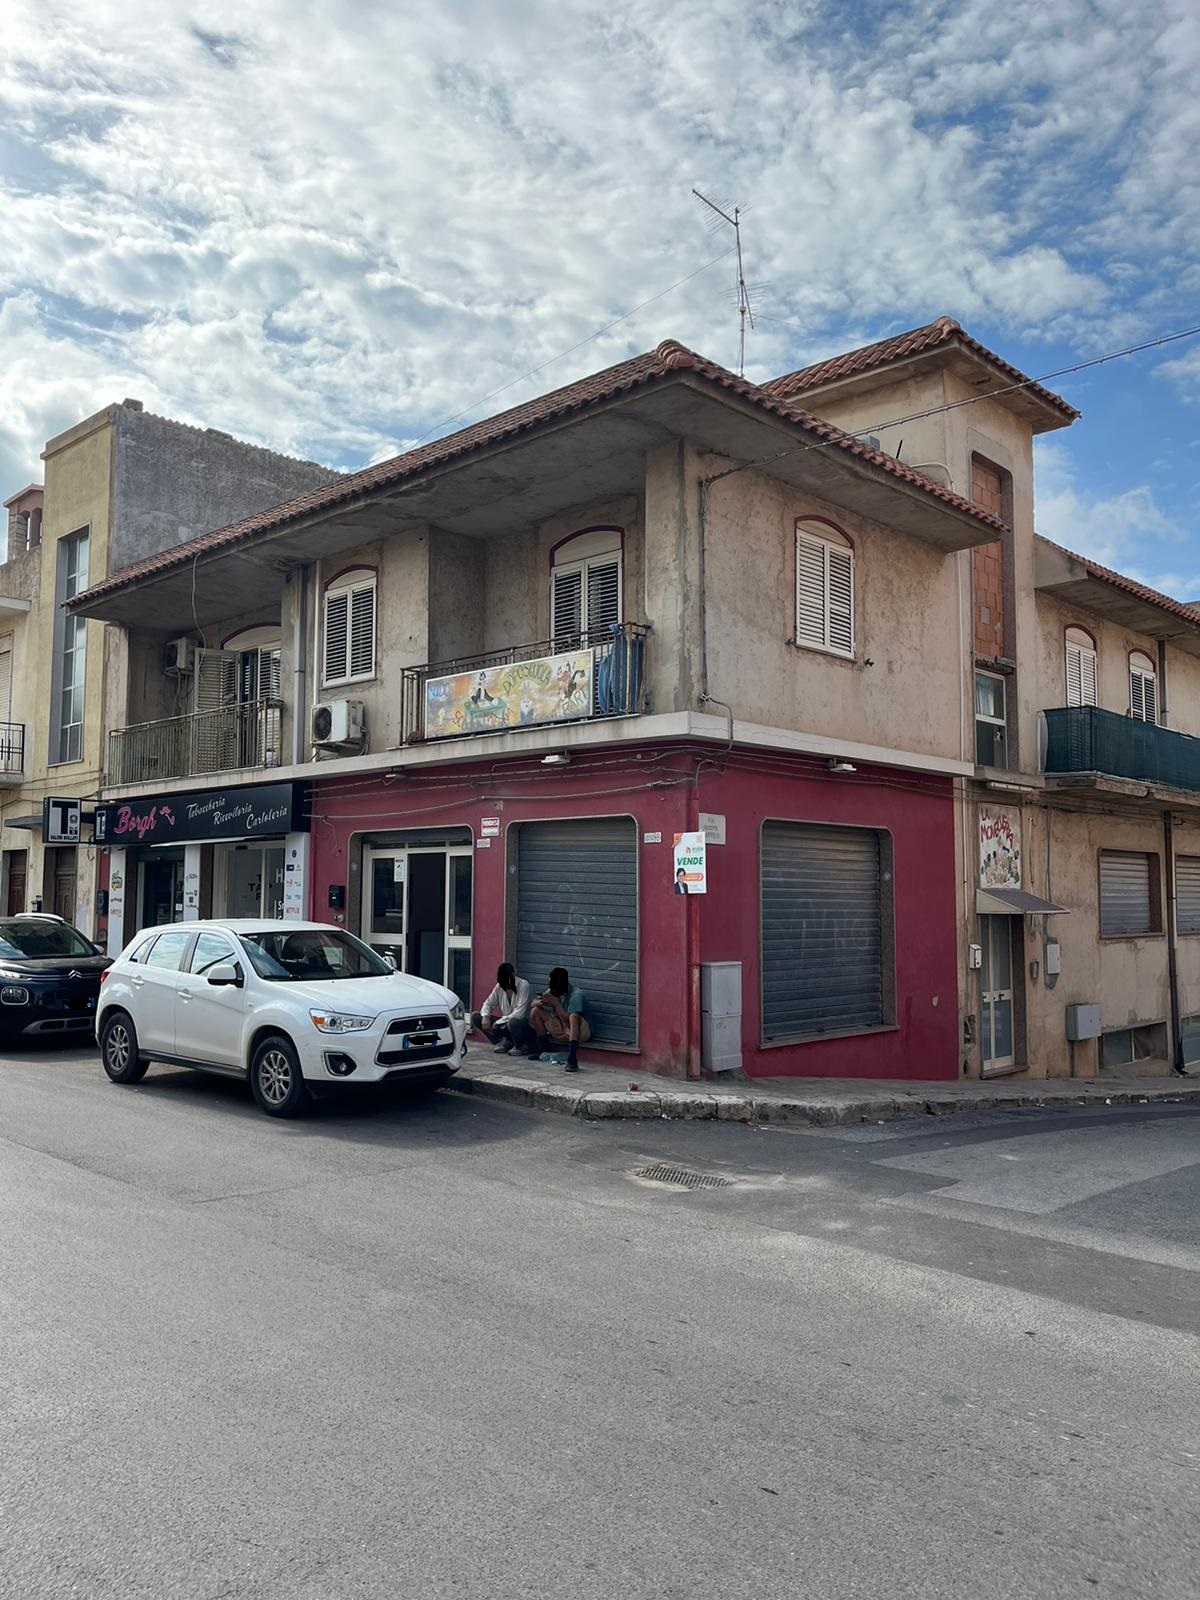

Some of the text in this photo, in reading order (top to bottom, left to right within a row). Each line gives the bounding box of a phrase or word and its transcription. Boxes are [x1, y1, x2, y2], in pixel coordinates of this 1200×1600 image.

[186, 797, 226, 820] Tabaccheria
[213, 803, 252, 825] Ricevitoria
[246, 806, 288, 830] Cartoleria
[677, 856, 703, 866] VENDE
